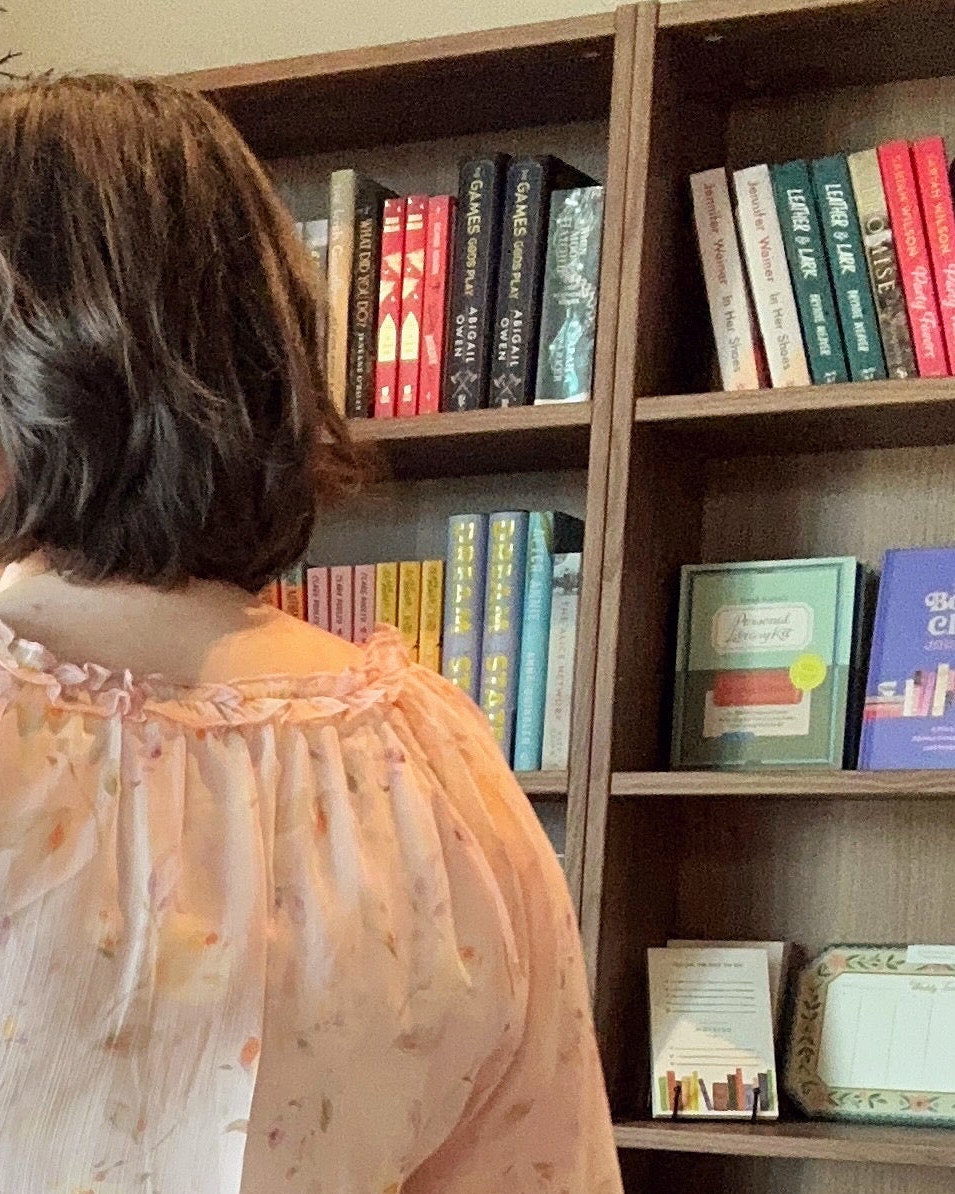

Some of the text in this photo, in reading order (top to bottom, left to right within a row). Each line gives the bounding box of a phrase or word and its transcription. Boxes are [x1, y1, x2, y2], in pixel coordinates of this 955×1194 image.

[359, 218, 373, 251] WHAT
[513, 181, 531, 236] GAMES
[703, 182, 730, 285] Jennifer Weiner
[746, 179, 775, 283] Jennifer Weiner
[786, 189, 818, 232] LEATHER
[824, 183, 848, 227] LEATHER
[836, 243, 856, 276] LARK
[900, 205, 918, 257] WILSON
[932, 203, 950, 254] WILSON
[464, 180, 483, 296] GAMES GODS PLAY
[795, 248, 818, 281] LARK
[508, 272, 521, 300] PLAY
[909, 265, 930, 310] Party
[454, 314, 465, 357] OWEN
[465, 306, 478, 363] ABIGAIL
[498, 317, 510, 361] OWEN
[510, 310, 523, 367] ABIGAIL
[722, 296, 743, 373] In Her Shoes
[769, 293, 792, 371] In Her Shoes
